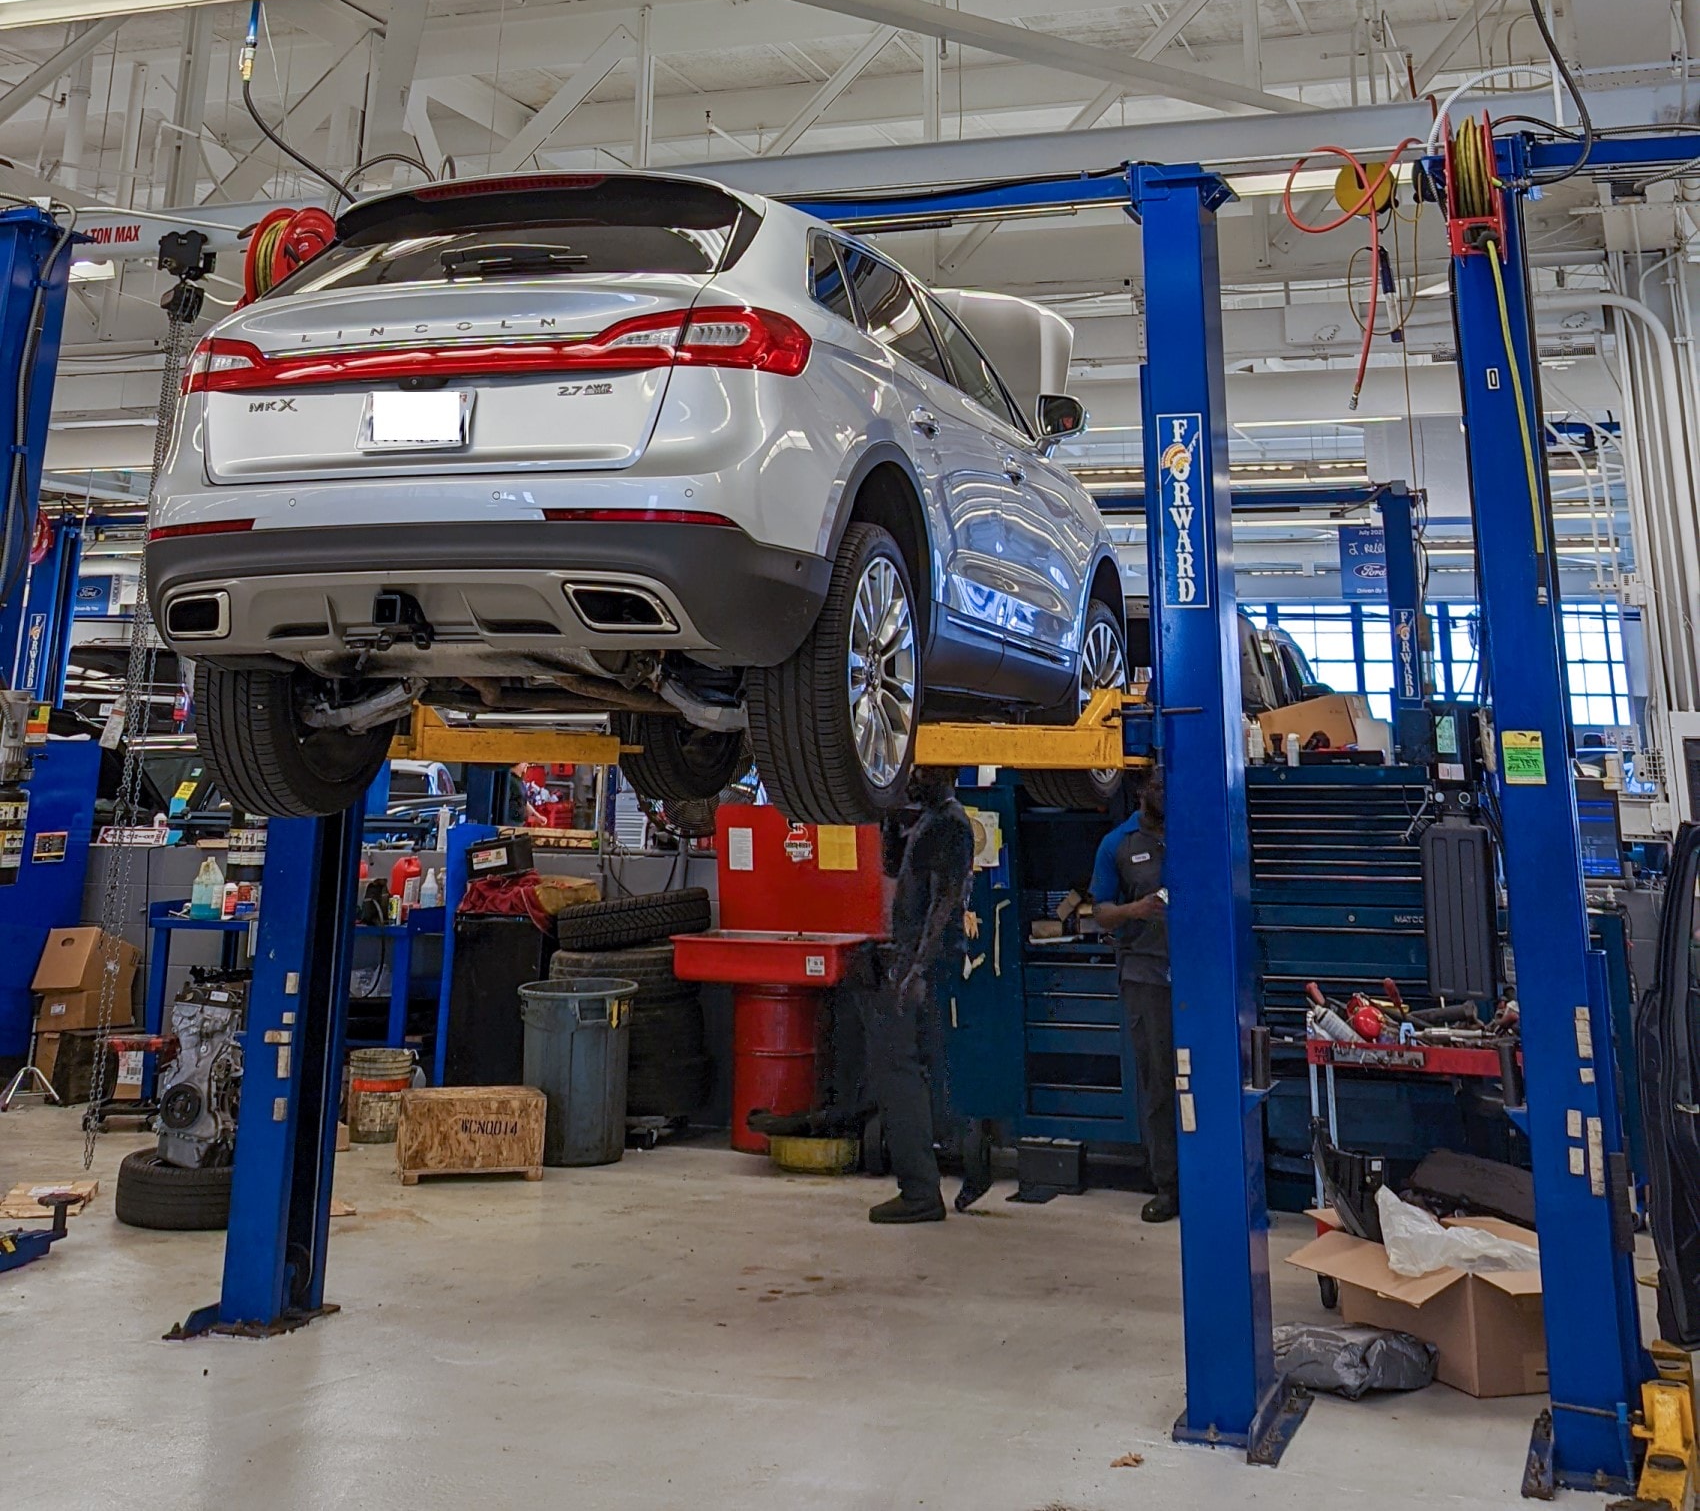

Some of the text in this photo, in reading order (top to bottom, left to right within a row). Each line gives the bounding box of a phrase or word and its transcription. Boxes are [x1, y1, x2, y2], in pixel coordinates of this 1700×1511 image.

[115, 224, 141, 243] MAX
[301, 317, 556, 343] LINCOLN
[557, 385, 583, 396] 2.7
[248, 398, 298, 413] MKX
[1169, 418, 1197, 603] FORWARD
[1361, 564, 1387, 576] Ford
